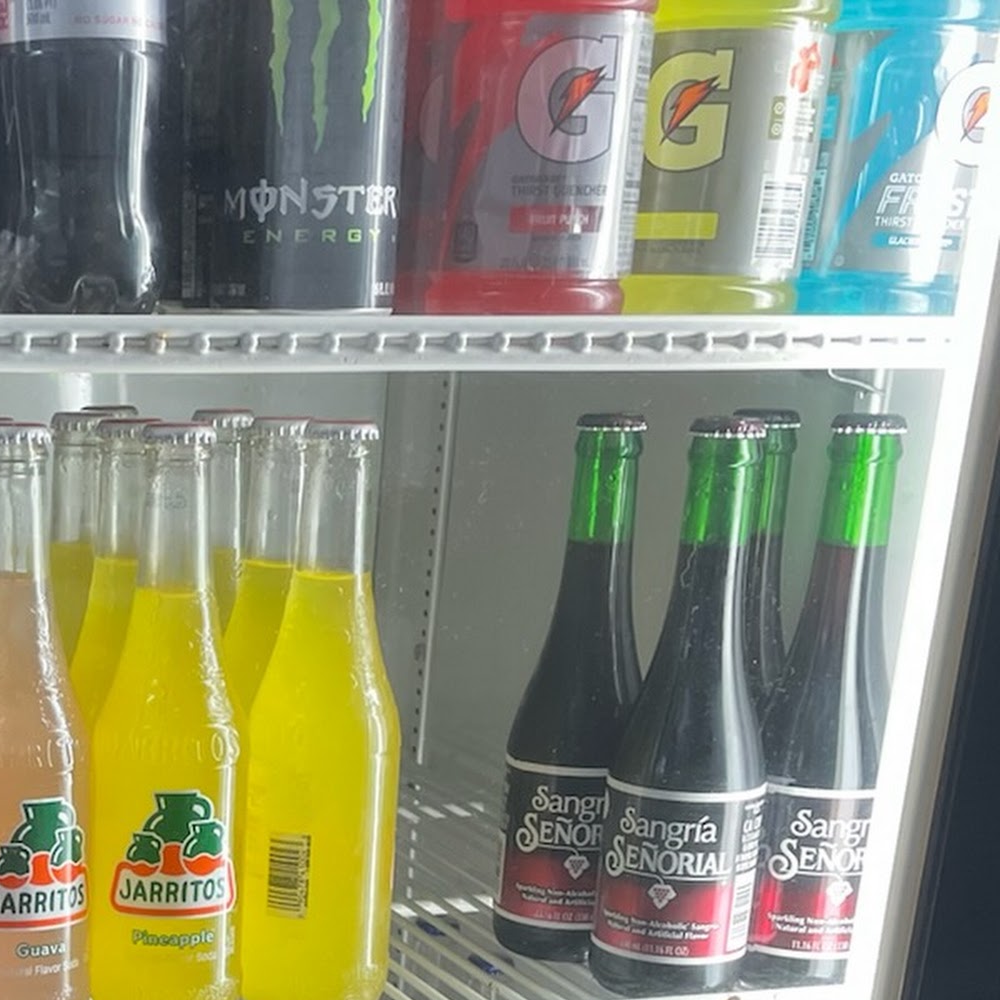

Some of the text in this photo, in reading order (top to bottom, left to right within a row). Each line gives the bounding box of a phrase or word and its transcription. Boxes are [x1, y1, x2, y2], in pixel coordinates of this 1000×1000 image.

[243, 229, 381, 244] ENERGY
[620, 806, 718, 850] Sangría
[604, 836, 733, 878] SEÑORIAL
[119, 876, 226, 904] JARRITOS
[16, 942, 67, 959] Guava
[131, 928, 215, 950] Pineapple
